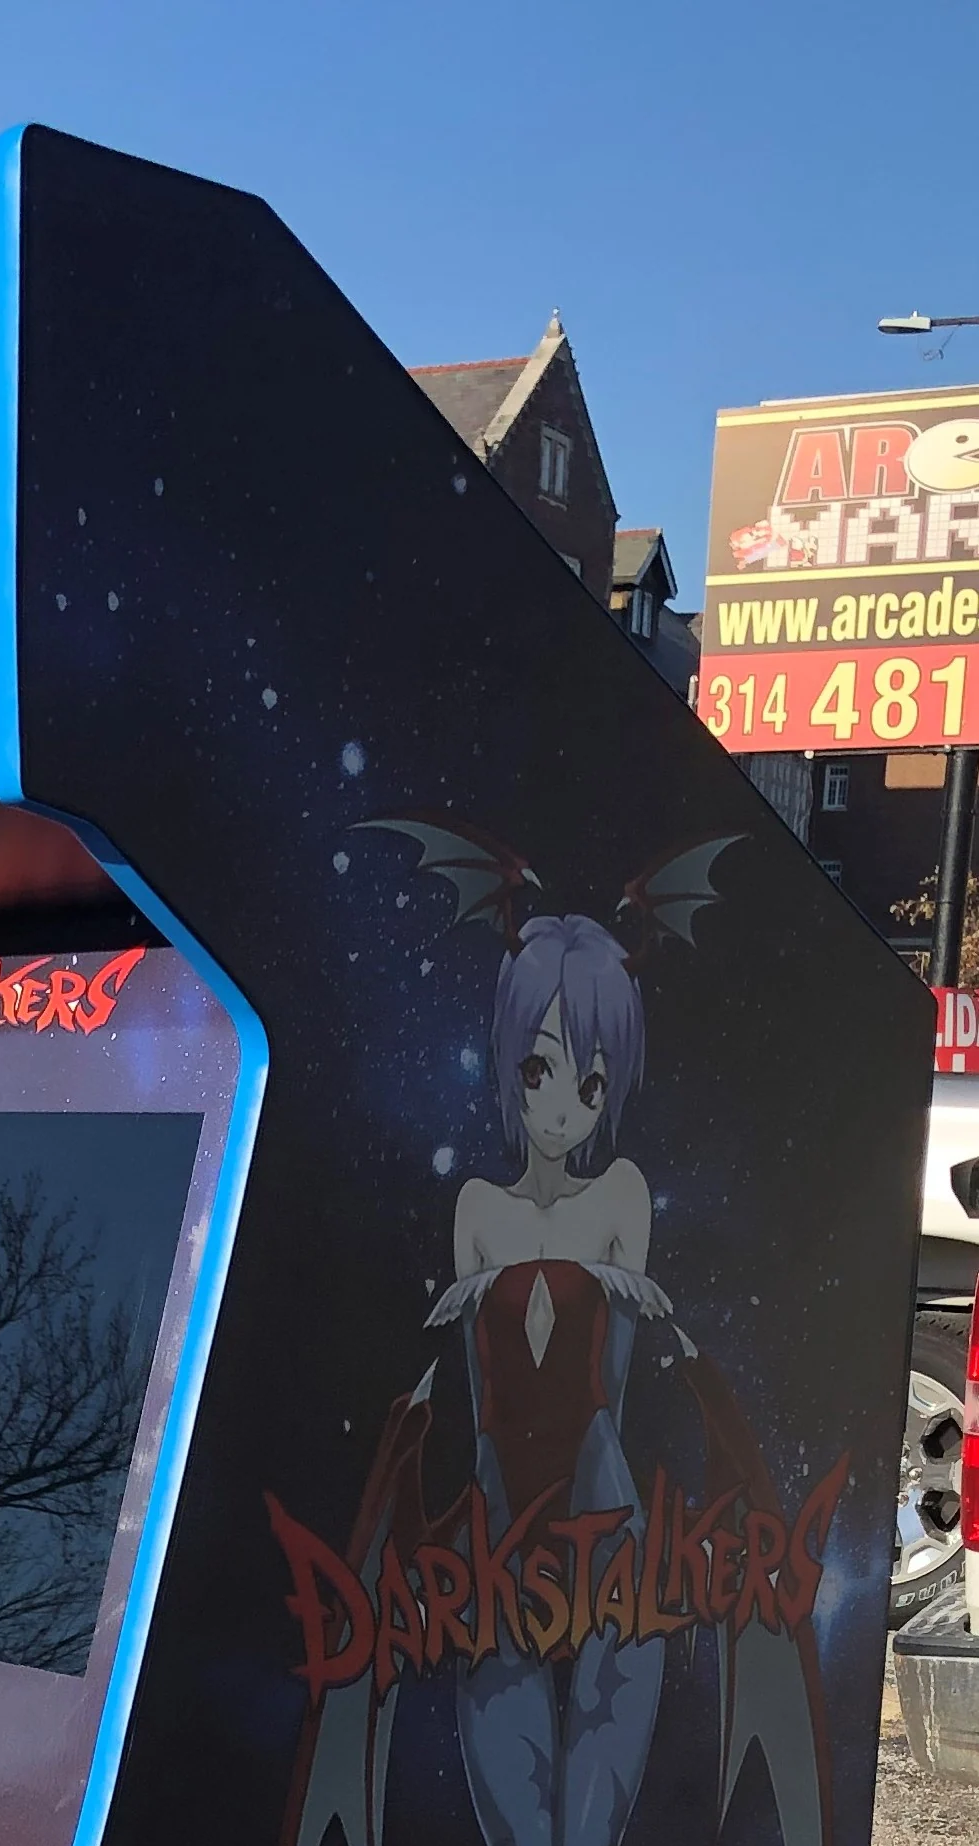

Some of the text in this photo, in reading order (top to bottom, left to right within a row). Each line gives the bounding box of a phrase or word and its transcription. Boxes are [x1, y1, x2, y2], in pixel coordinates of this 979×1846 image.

[718, 576, 979, 647] www.arcade
[708, 654, 968, 741] 314 481
[264, 1451, 851, 1703] DARKSTALKERS
